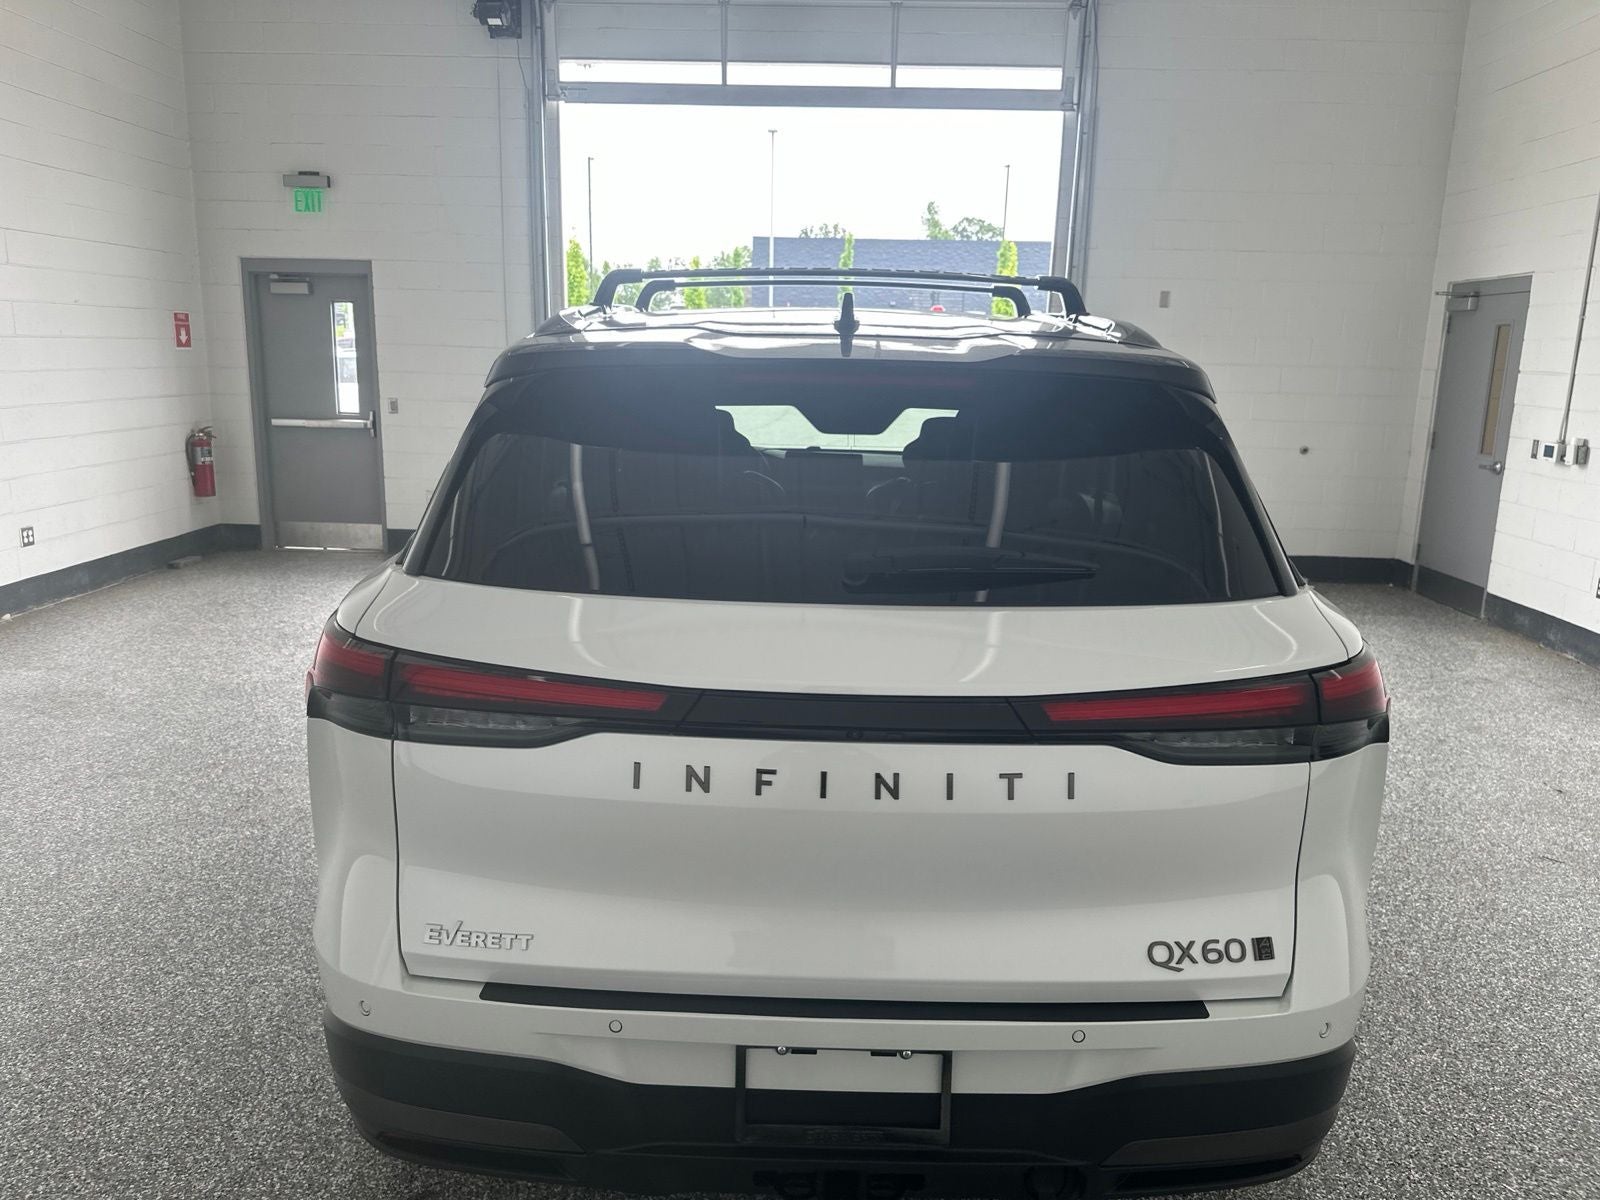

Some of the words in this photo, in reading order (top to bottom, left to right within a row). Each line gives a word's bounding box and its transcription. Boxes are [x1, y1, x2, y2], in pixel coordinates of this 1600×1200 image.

[295, 190, 323, 212] EXIT
[633, 762, 1075, 800] INFINITI
[1147, 938, 1247, 972] QX60
